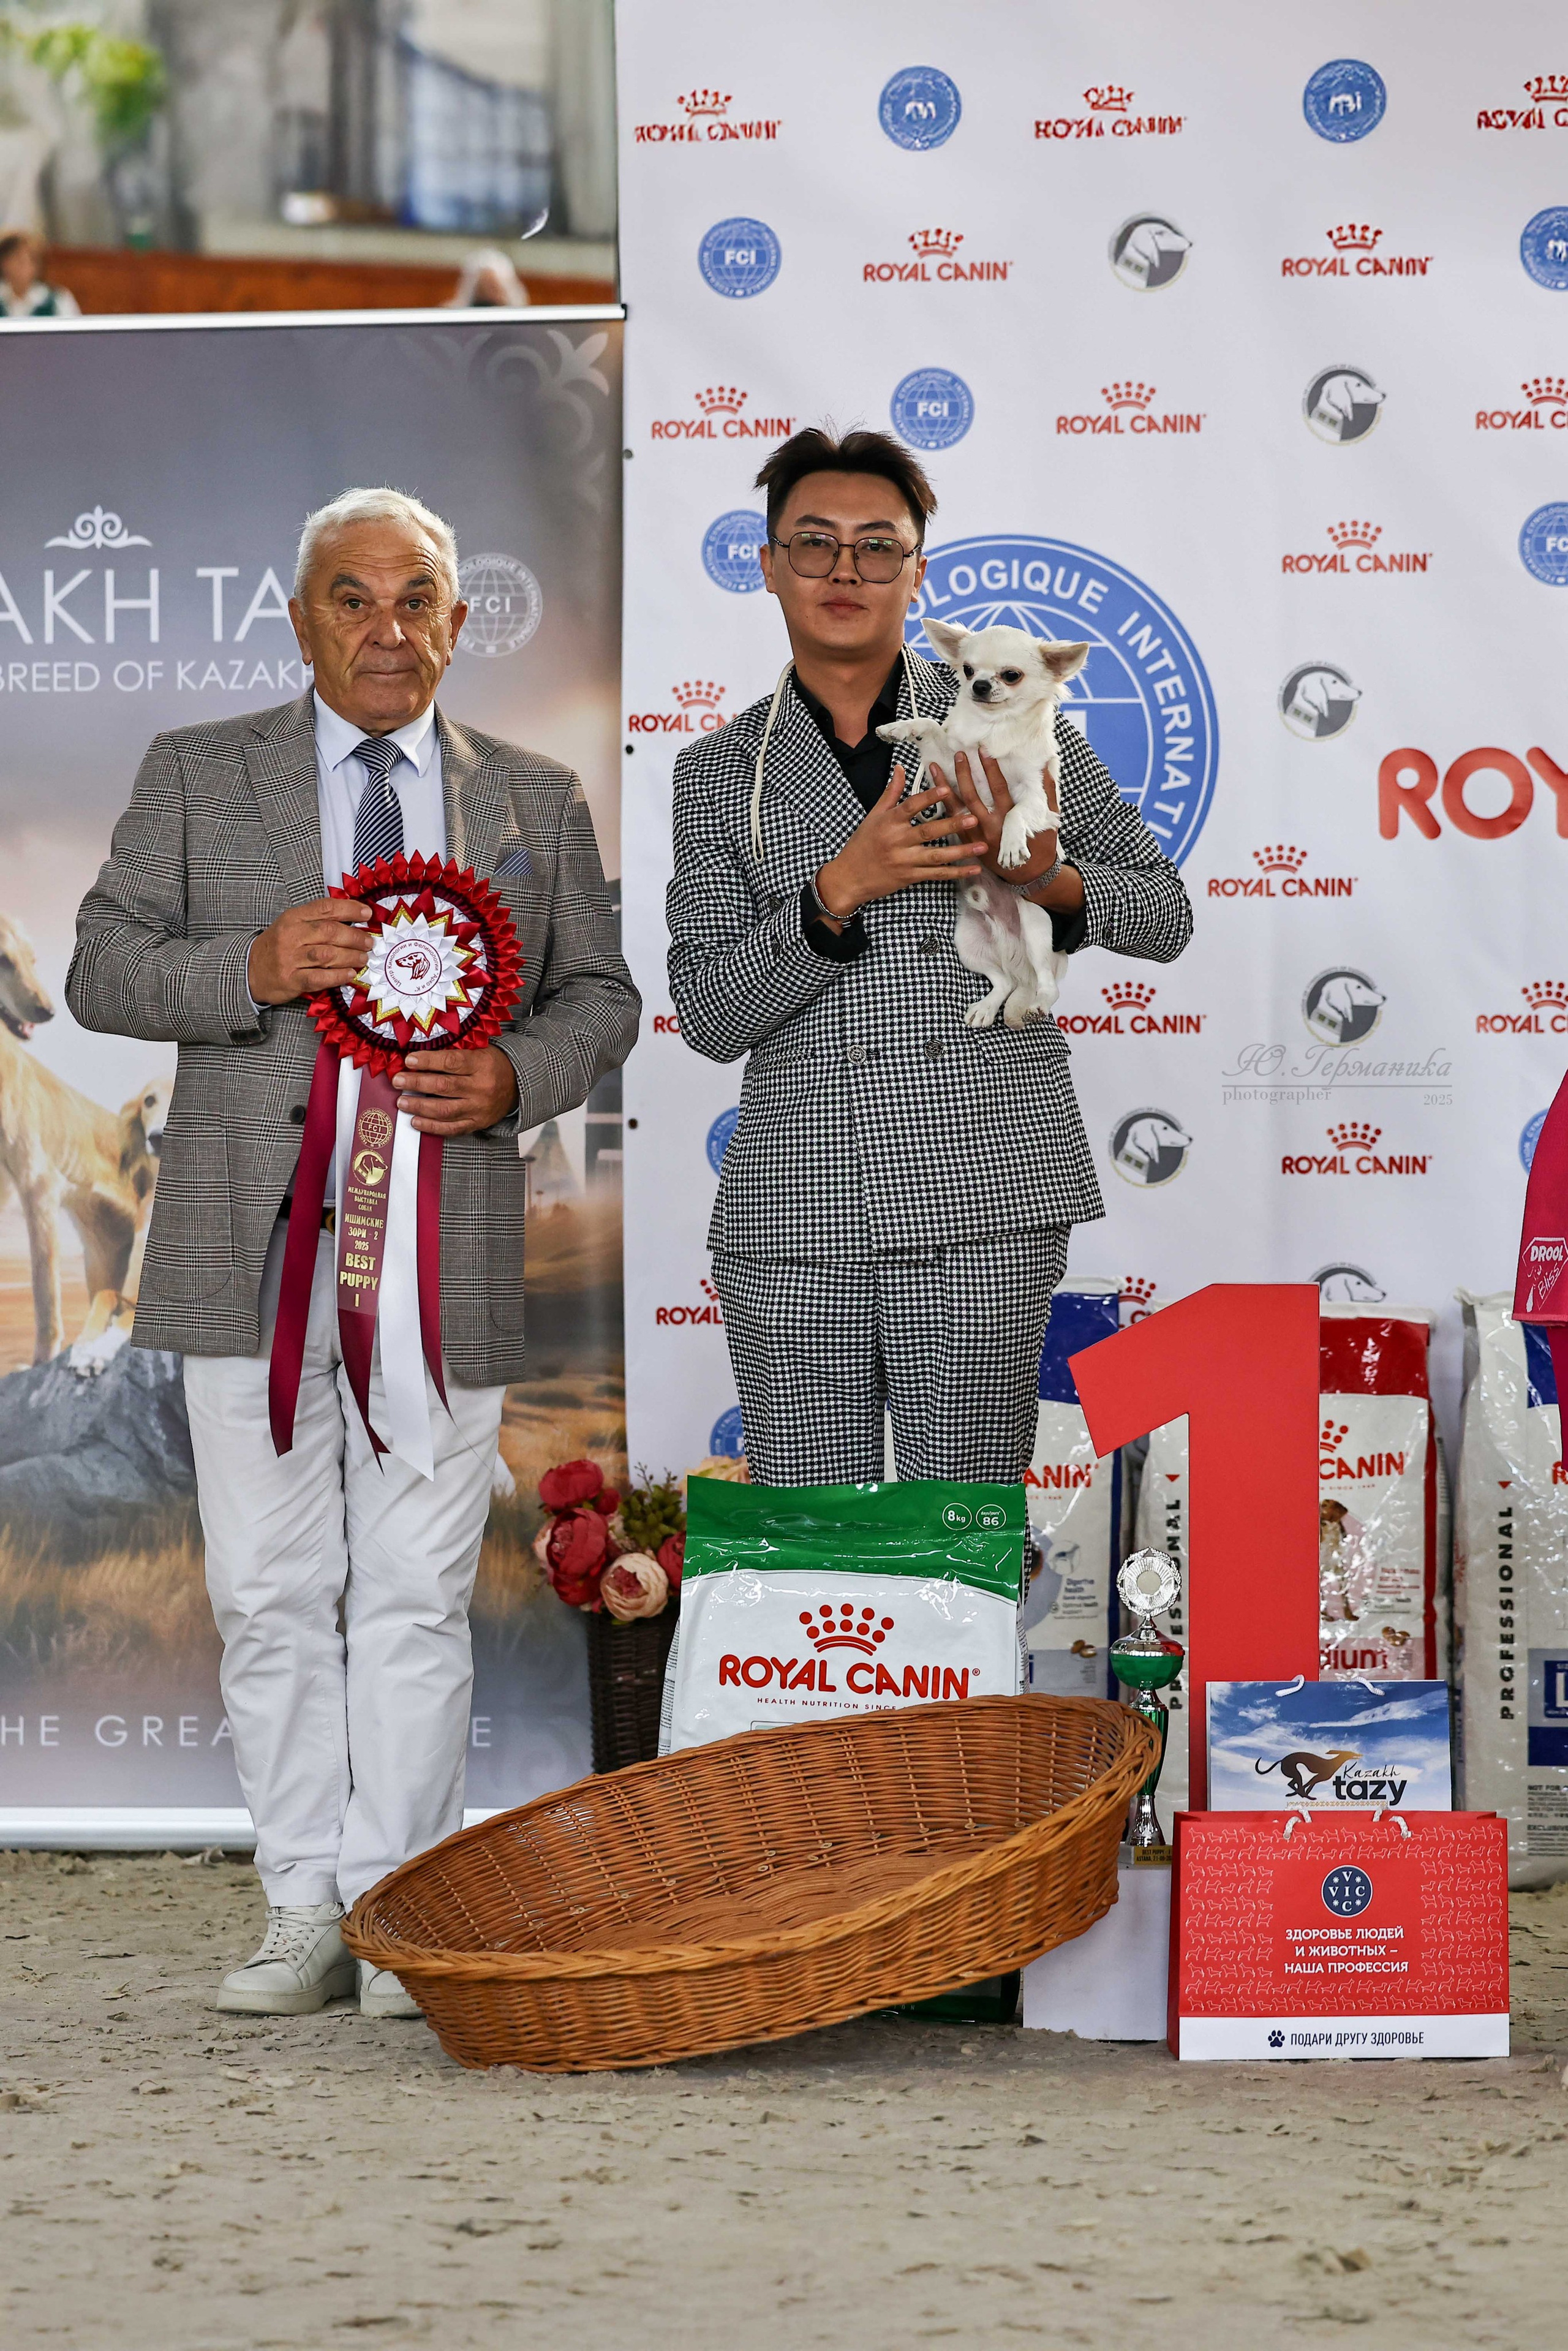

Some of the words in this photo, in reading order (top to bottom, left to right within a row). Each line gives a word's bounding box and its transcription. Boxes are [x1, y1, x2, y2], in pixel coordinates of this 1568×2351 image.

[724, 249, 756, 265] FCI
[864, 263, 930, 282] ROYAL
[937, 262, 1008, 281] CANIN
[1282, 258, 1350, 276] ROYAL
[917, 401, 949, 417] FCI
[652, 420, 717, 439] ROYAL
[723, 418, 793, 438] CANIN
[1057, 415, 1124, 434] ROYAL
[1130, 414, 1201, 434] CANIN
[1476, 410, 1544, 430] ROYAL
[727, 544, 758, 560] FCI
[1282, 554, 1351, 573] ROYAL
[1357, 553, 1428, 572] CANIN
[470, 595, 511, 614] FCI
[0, 660, 100, 693] REED
[113, 660, 164, 693] OF
[628, 714, 695, 733] ROYAL
[1208, 879, 1276, 897] ROYAL
[1282, 878, 1352, 897] CANIN
[387, 944, 407, 969] Кинологии
[414, 942, 439, 971] Фелинологии
[389, 970, 402, 987] Центр
[1057, 1014, 1125, 1035] ROYAL
[1130, 1014, 1201, 1034] CANIN
[1476, 1014, 1544, 1033] ROYAL
[368, 1123, 382, 1133] FCI
[1282, 1156, 1350, 1175] ROYAL
[1356, 1155, 1427, 1175] CANIN
[347, 1186, 386, 1200] МЕЖДУНАРОДНАЯ
[354, 1195, 378, 1206] ВЫСТАВКА
[344, 1213, 384, 1229] ИШИМСКИЕ
[348, 1226, 367, 1239] ЗОРИ
[374, 1231, 378, 1240] 2
[354, 1240, 369, 1251] 2025
[1530, 1245, 1564, 1262] DROOL
[345, 1252, 376, 1271] BEST
[339, 1270, 379, 1291] PUPPY
[1537, 1262, 1560, 1300] Bliss
[657, 1306, 724, 1326] ROYAL
[1320, 1451, 1404, 1481] CANIN
[1023, 1463, 1092, 1489] ANIN
[982, 1517, 999, 1526] 86
[1498, 1506, 1515, 1720] PROFESSIONAL
[719, 1654, 837, 1692] ROYAL
[802, 1700, 859, 1709] NUTRITION
[1344, 1762, 1401, 1779] Kazakh
[1332, 1775, 1408, 1806] tazy
[1286, 1928, 1352, 1941] ЗДОРОВЬЕ
[1355, 1925, 1404, 1941] ЛЮДЕЙ
[1295, 1945, 1305, 1957] И
[1308, 1945, 1386, 1957] ЖИВОТНЫХ
[1284, 1962, 1324, 1974] НАША
[1327, 1961, 1409, 1974] ПРОФЕССИЯ
[1291, 2032, 1332, 2047] ПОДАРИ
[1335, 2032, 1368, 2047] ДРУГУ
[1371, 2031, 1425, 2047] ЗДОРОВЬЕ
